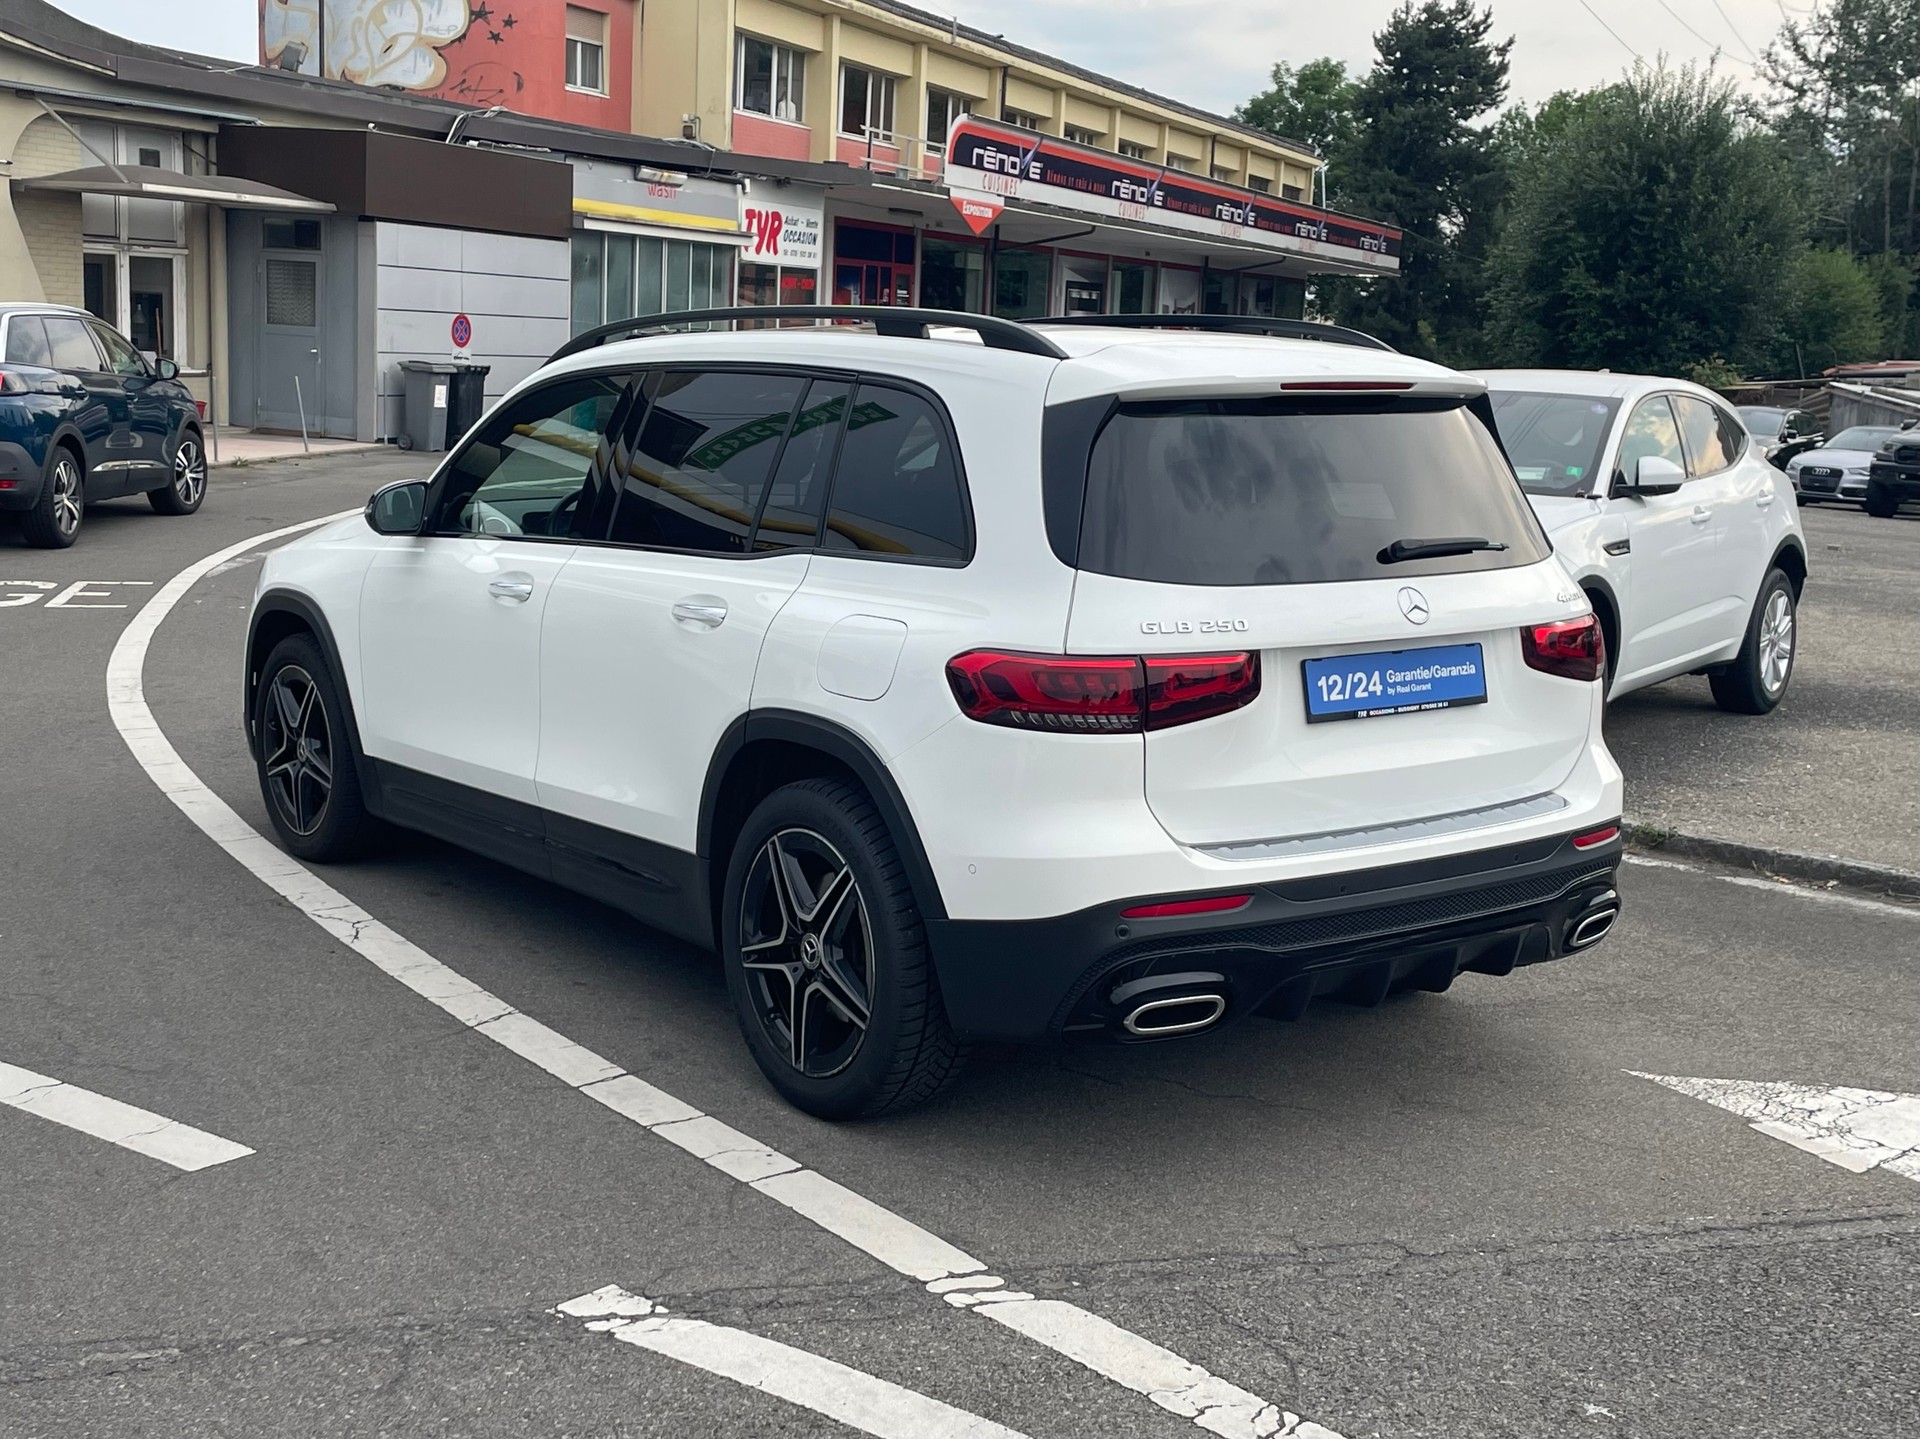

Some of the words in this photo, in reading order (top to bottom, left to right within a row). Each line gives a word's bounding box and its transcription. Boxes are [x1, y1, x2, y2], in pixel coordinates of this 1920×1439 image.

[982, 173, 1018, 195] CUISINES
[743, 208, 783, 256] TYR
[783, 229, 819, 246] OCCASION
[1140, 621, 1193, 634] GLB
[1199, 618, 1249, 633] 250
[1386, 661, 1476, 683] Garantie/Garanzia
[1317, 670, 1383, 702] 12/24
[1387, 686, 1395, 695] by
[1397, 683, 1410, 694] Real
[1411, 682, 1432, 692] Garant
